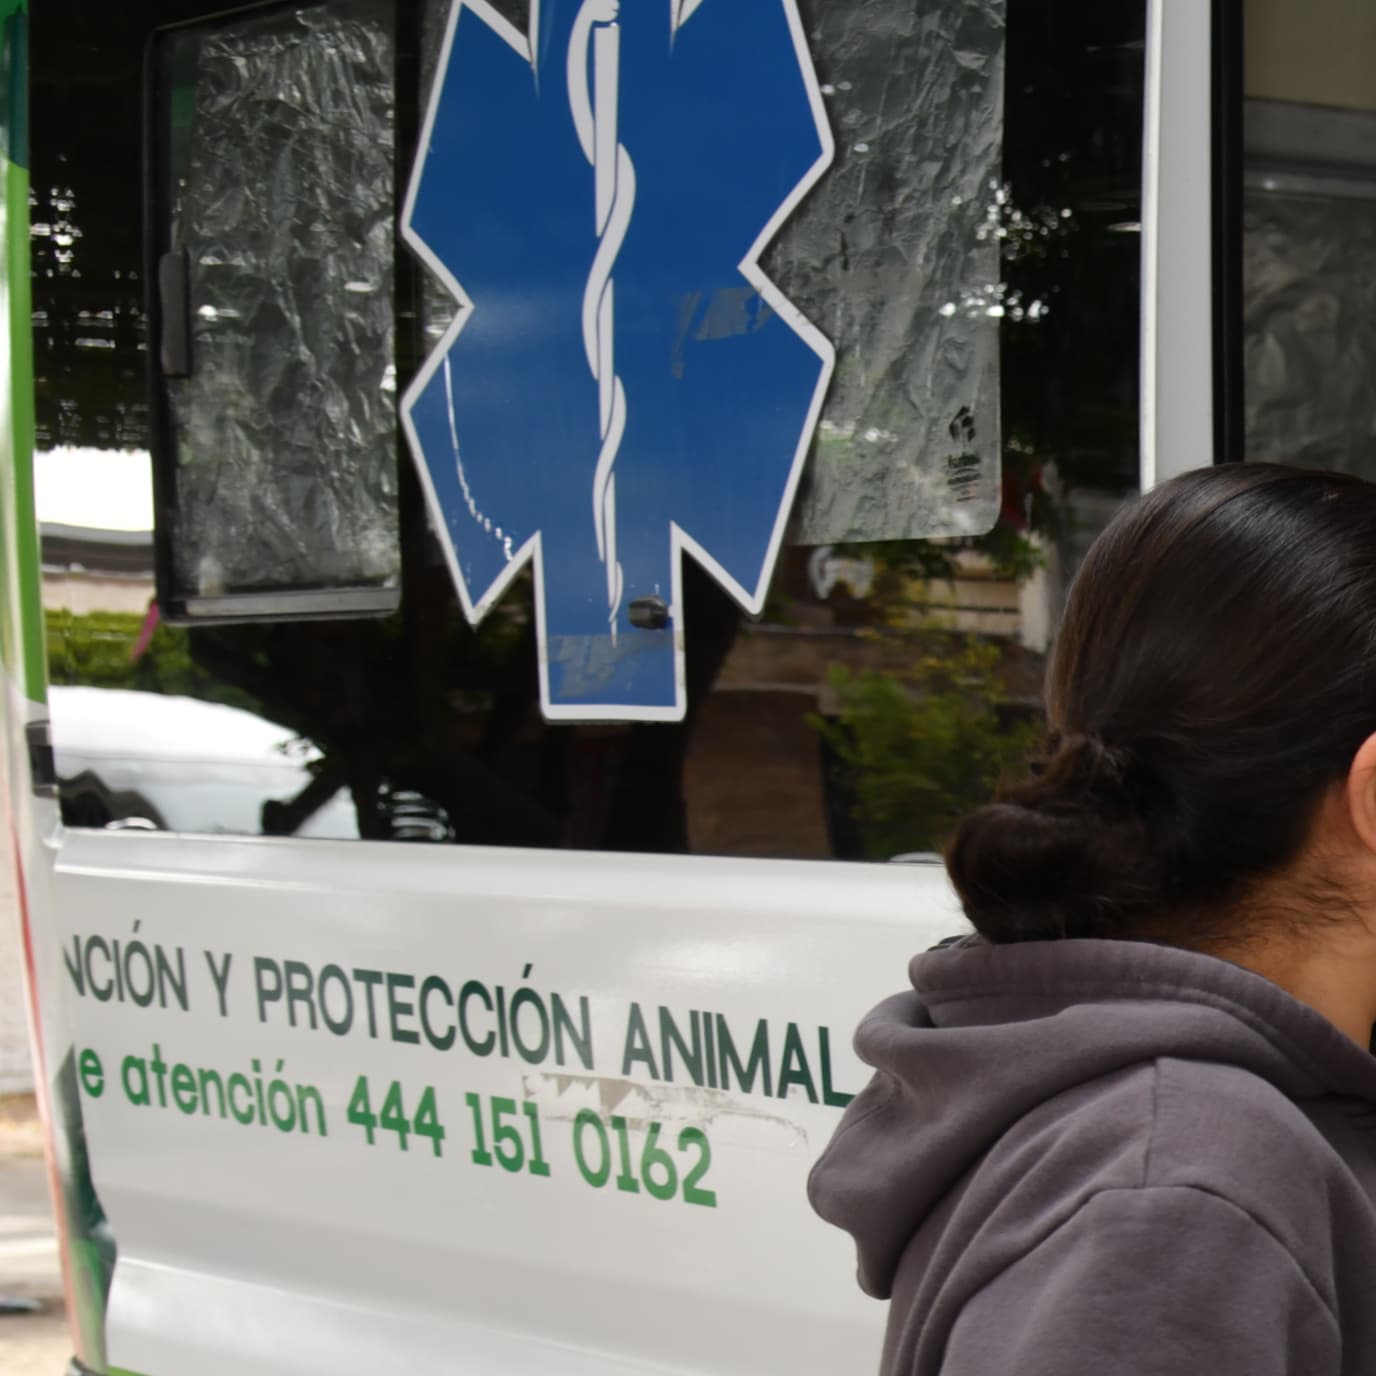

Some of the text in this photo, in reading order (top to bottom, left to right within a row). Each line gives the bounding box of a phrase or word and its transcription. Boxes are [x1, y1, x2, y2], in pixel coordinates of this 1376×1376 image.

[203, 950, 232, 1018] Y
[253, 956, 595, 1070] PROTECCIÓN
[621, 1001, 857, 1109] ANIMAL
[121, 1043, 328, 1136] atención
[346, 1075, 446, 1158] 444
[465, 1091, 551, 1177] 151
[572, 1107, 718, 1208] 0162
